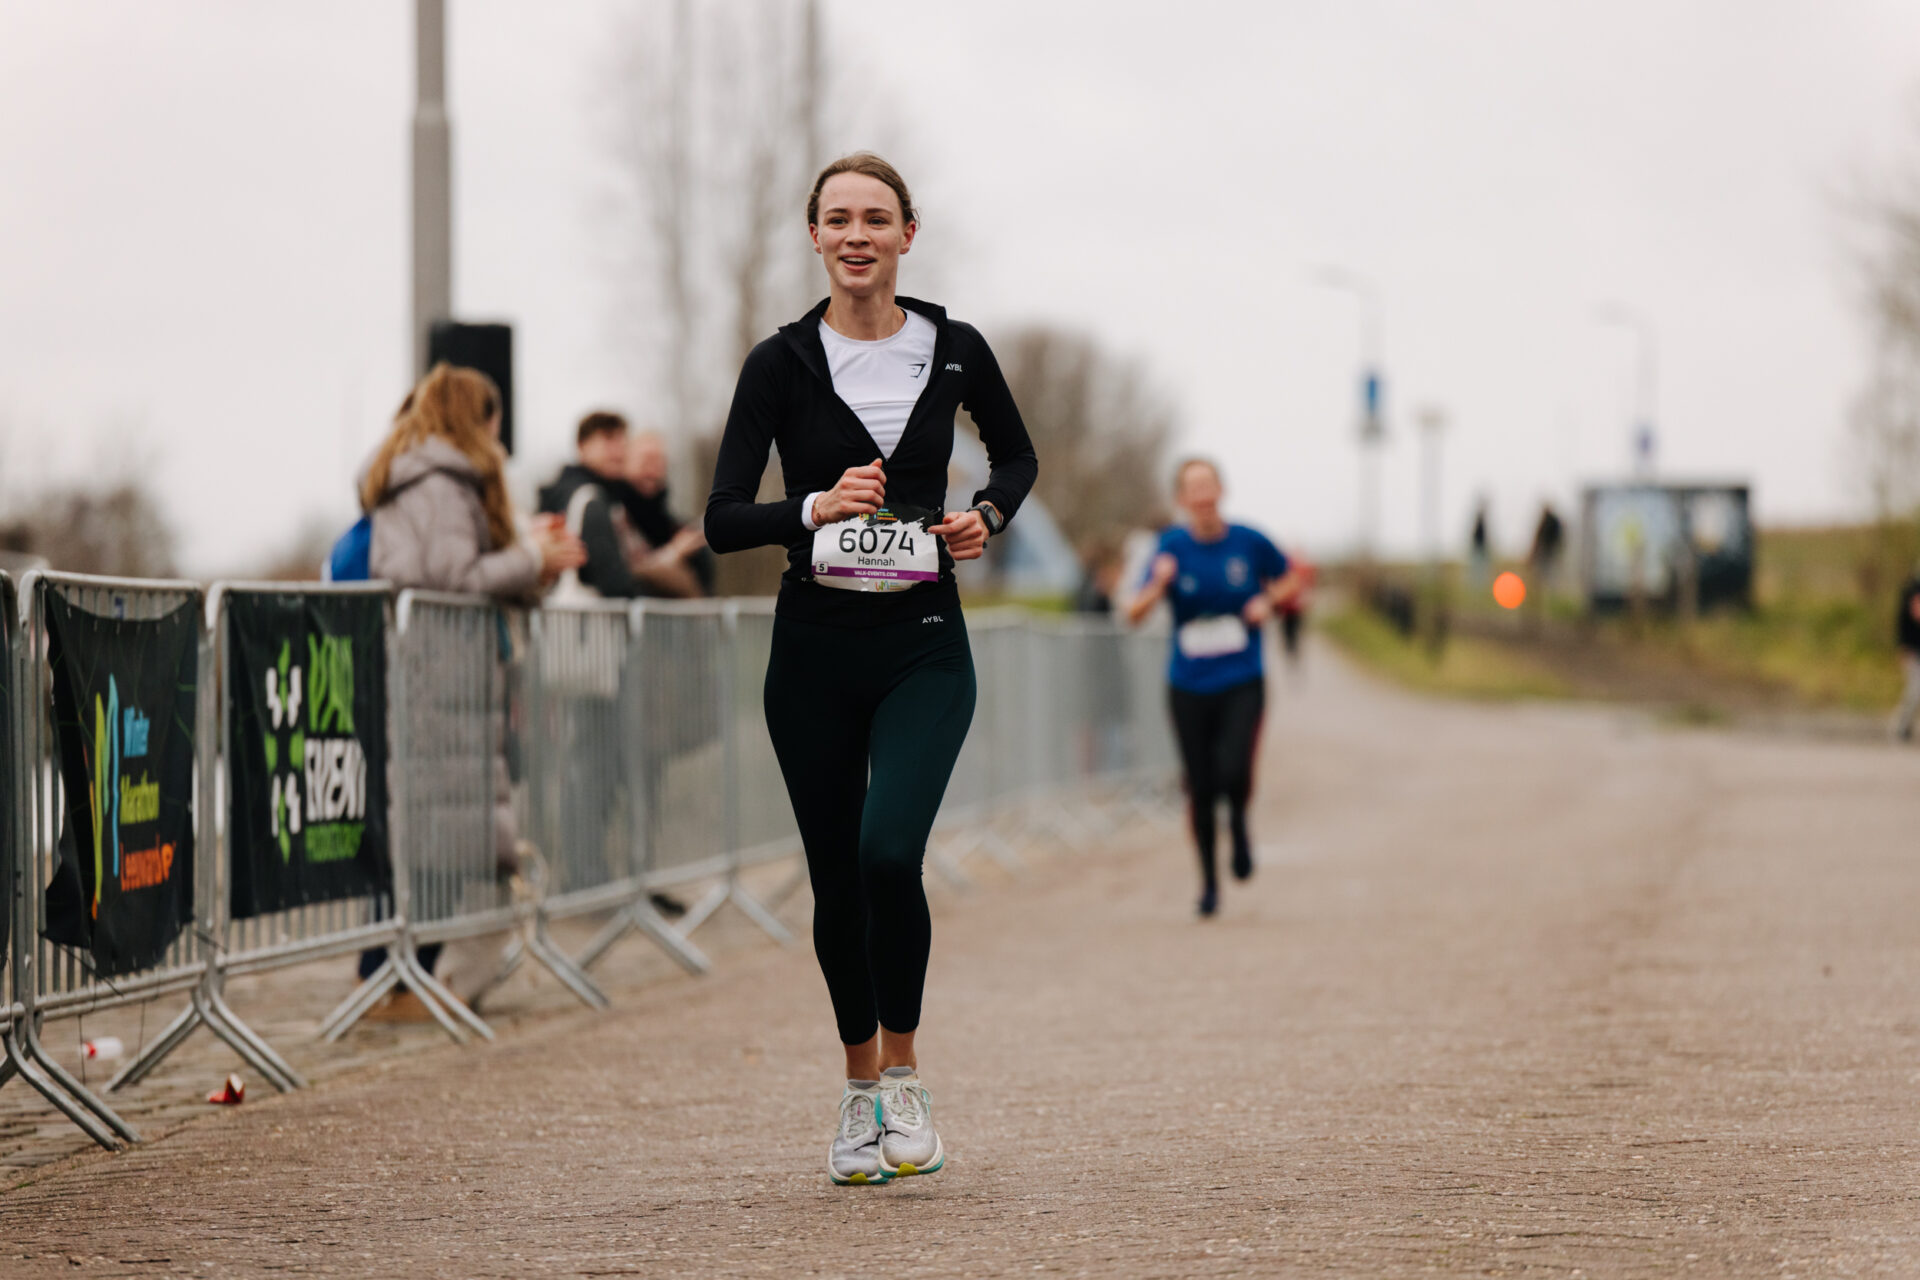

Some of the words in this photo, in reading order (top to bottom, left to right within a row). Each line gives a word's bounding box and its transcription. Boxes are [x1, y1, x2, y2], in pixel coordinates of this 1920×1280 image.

[945, 363, 962, 372] AYBL
[839, 528, 915, 556] 6074
[857, 556, 895, 567] Hannah
[819, 564, 825, 572] 5
[922, 615, 944, 624] AYBL
